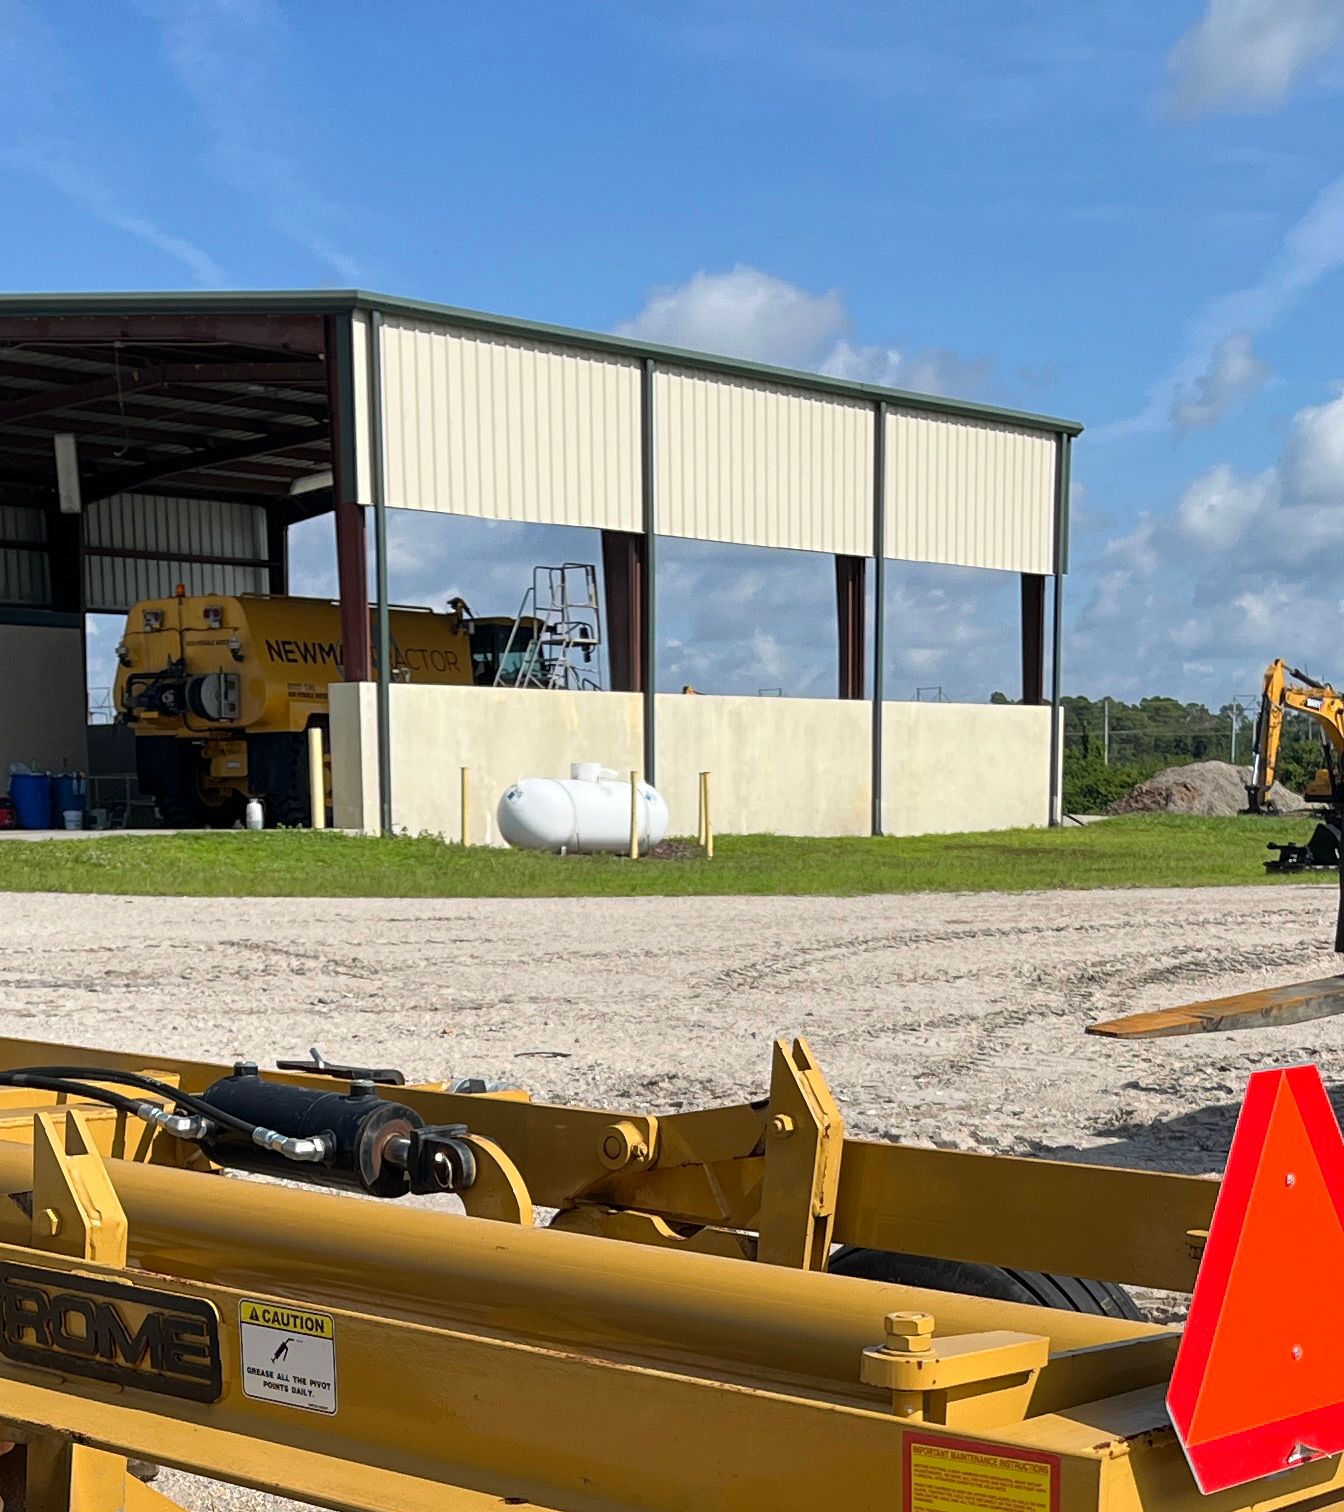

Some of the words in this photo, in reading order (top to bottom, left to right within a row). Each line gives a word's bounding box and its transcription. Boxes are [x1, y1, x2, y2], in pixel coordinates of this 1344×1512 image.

[3, 1283, 212, 1377] ROME
[261, 1309, 325, 1333] CAUTION
[246, 1366, 274, 1379] GREASE
[276, 1372, 290, 1382] ALL
[293, 1375, 307, 1386] THE
[310, 1379, 331, 1391] PIVOT
[263, 1380, 289, 1393] POINTS
[913, 1445, 949, 1461] IMPORTANT
[950, 1450, 998, 1467] MAINTENANCE
[999, 1458, 1049, 1474] INSTRUCTIONS
